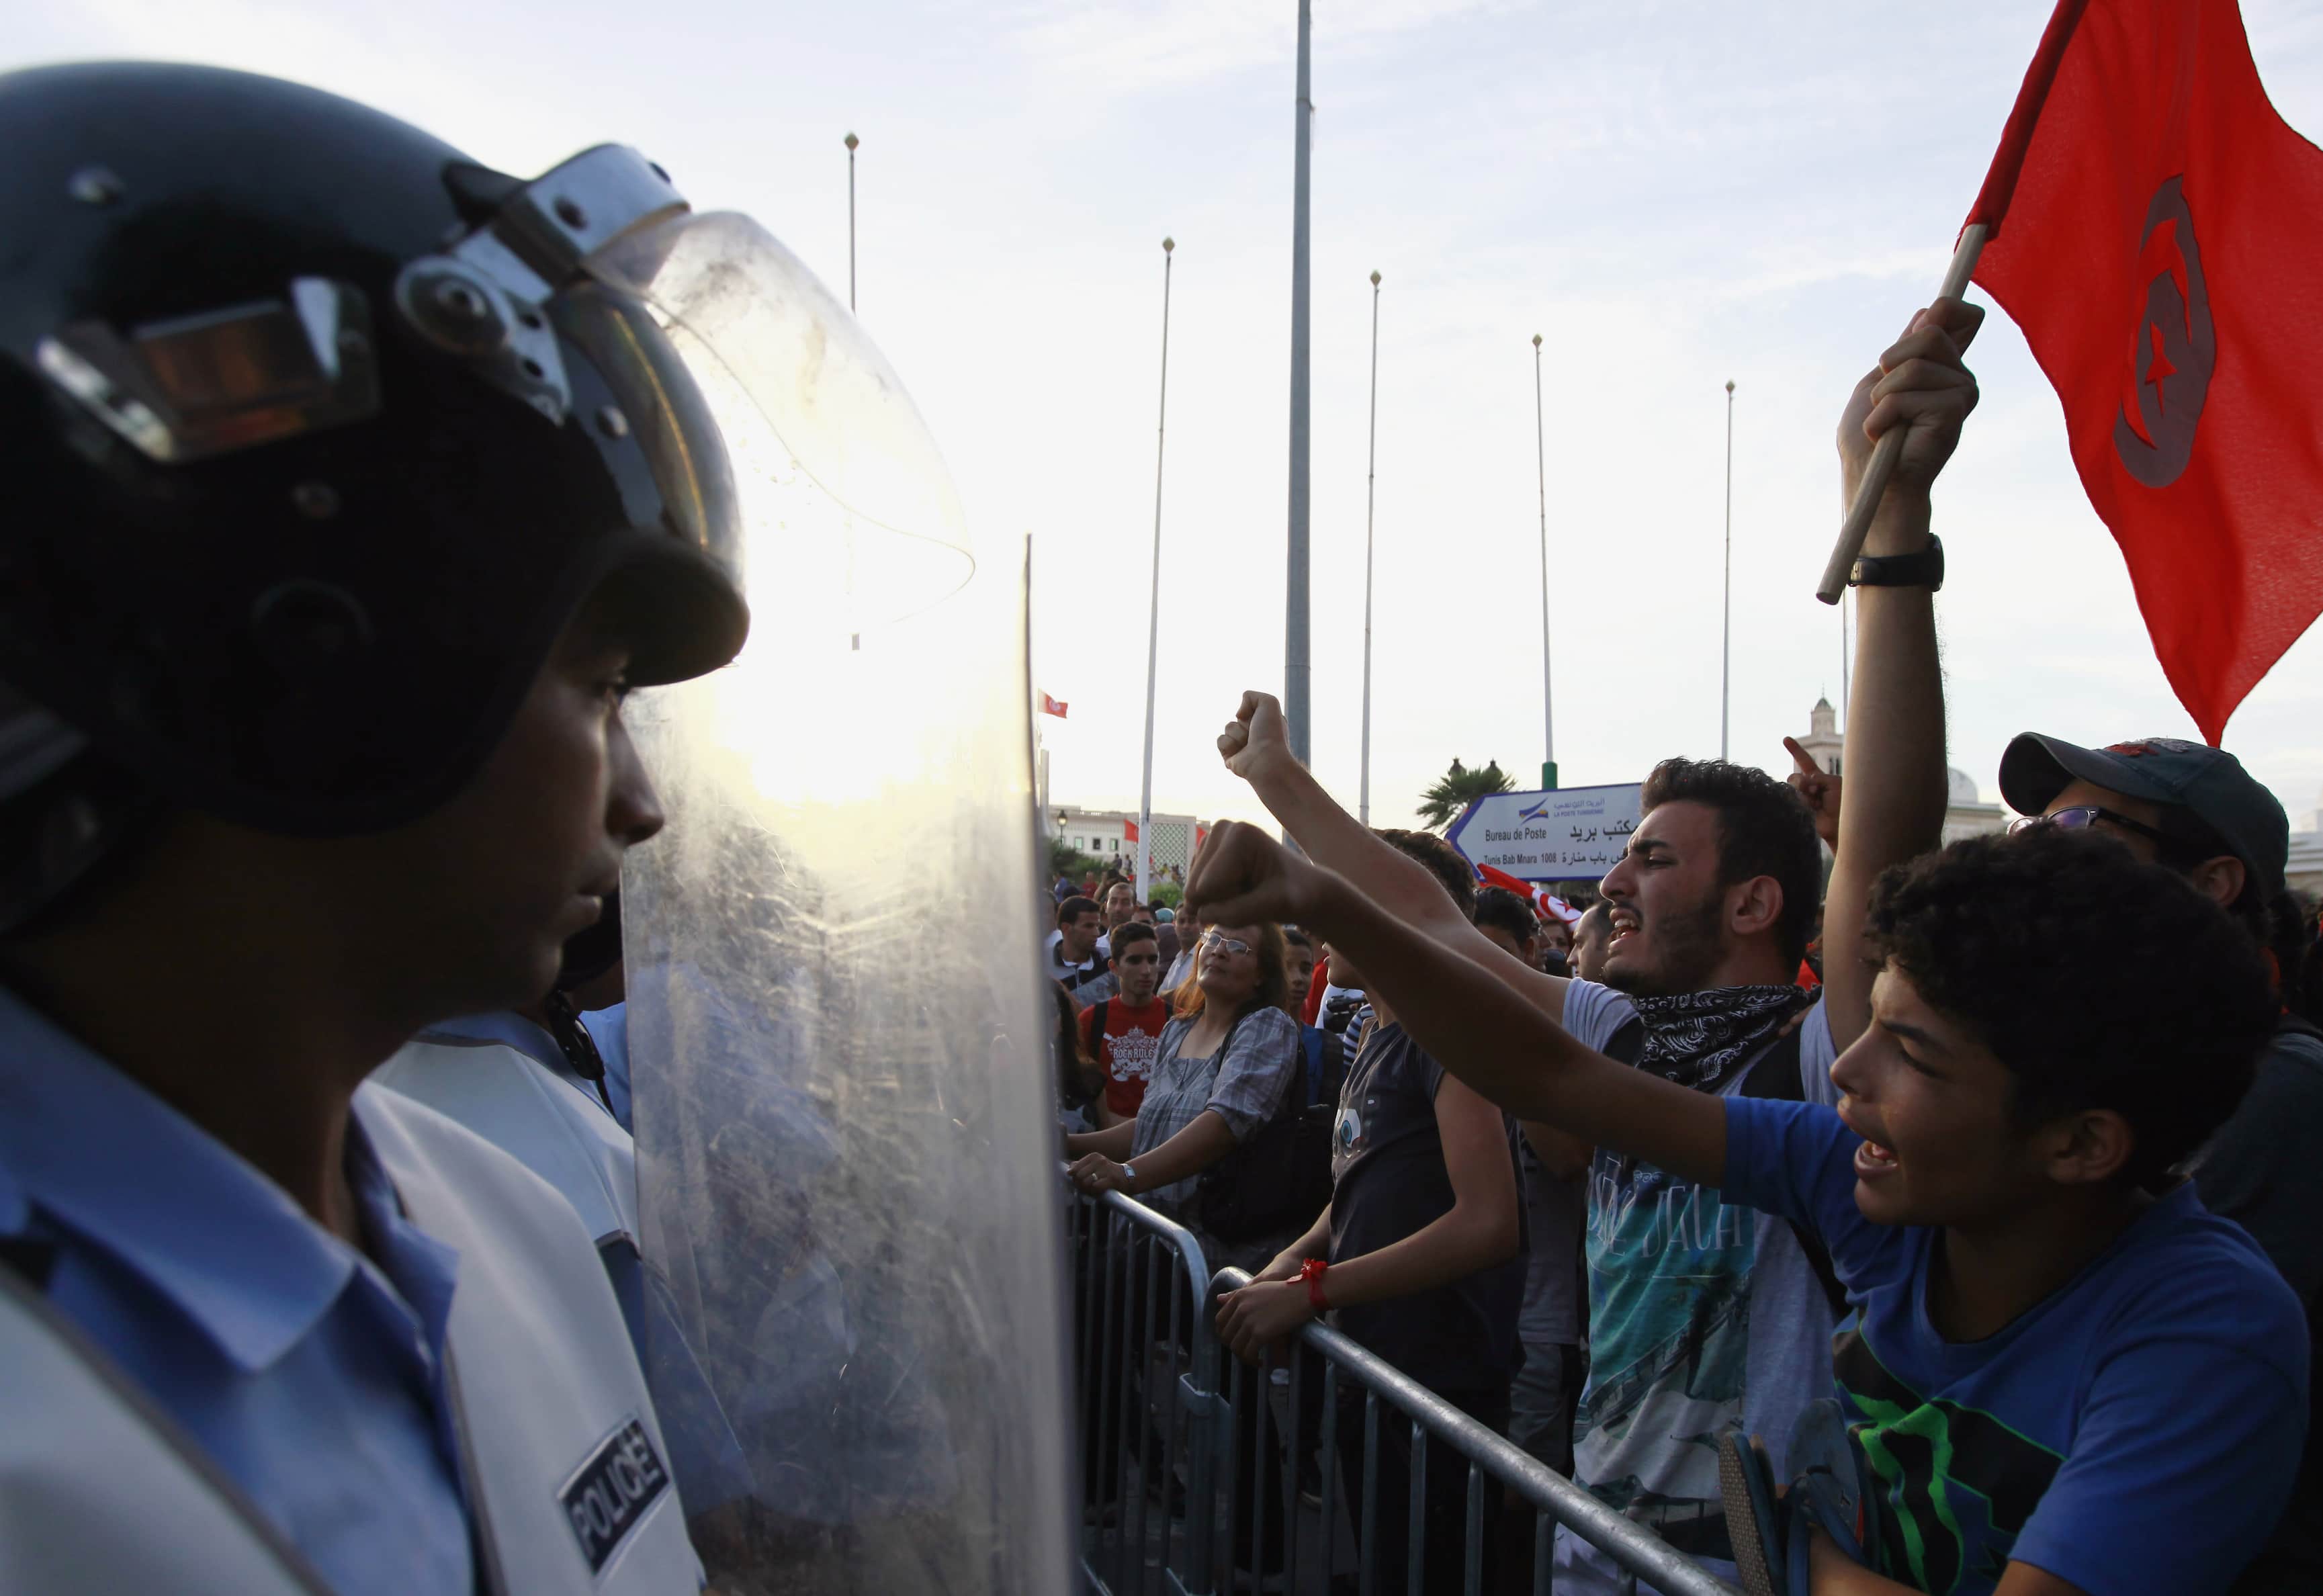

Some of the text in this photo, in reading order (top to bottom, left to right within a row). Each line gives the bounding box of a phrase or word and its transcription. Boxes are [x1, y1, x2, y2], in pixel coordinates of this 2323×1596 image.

[1485, 827, 1547, 841] Bureau de Poste
[1570, 825, 1597, 842] بريد
[1484, 852, 1557, 865] Tunis Bab Mnara 1008
[1562, 852, 1586, 865] منارة
[1590, 851, 1607, 864] باب
[571, 1428, 660, 1558] POLICE
